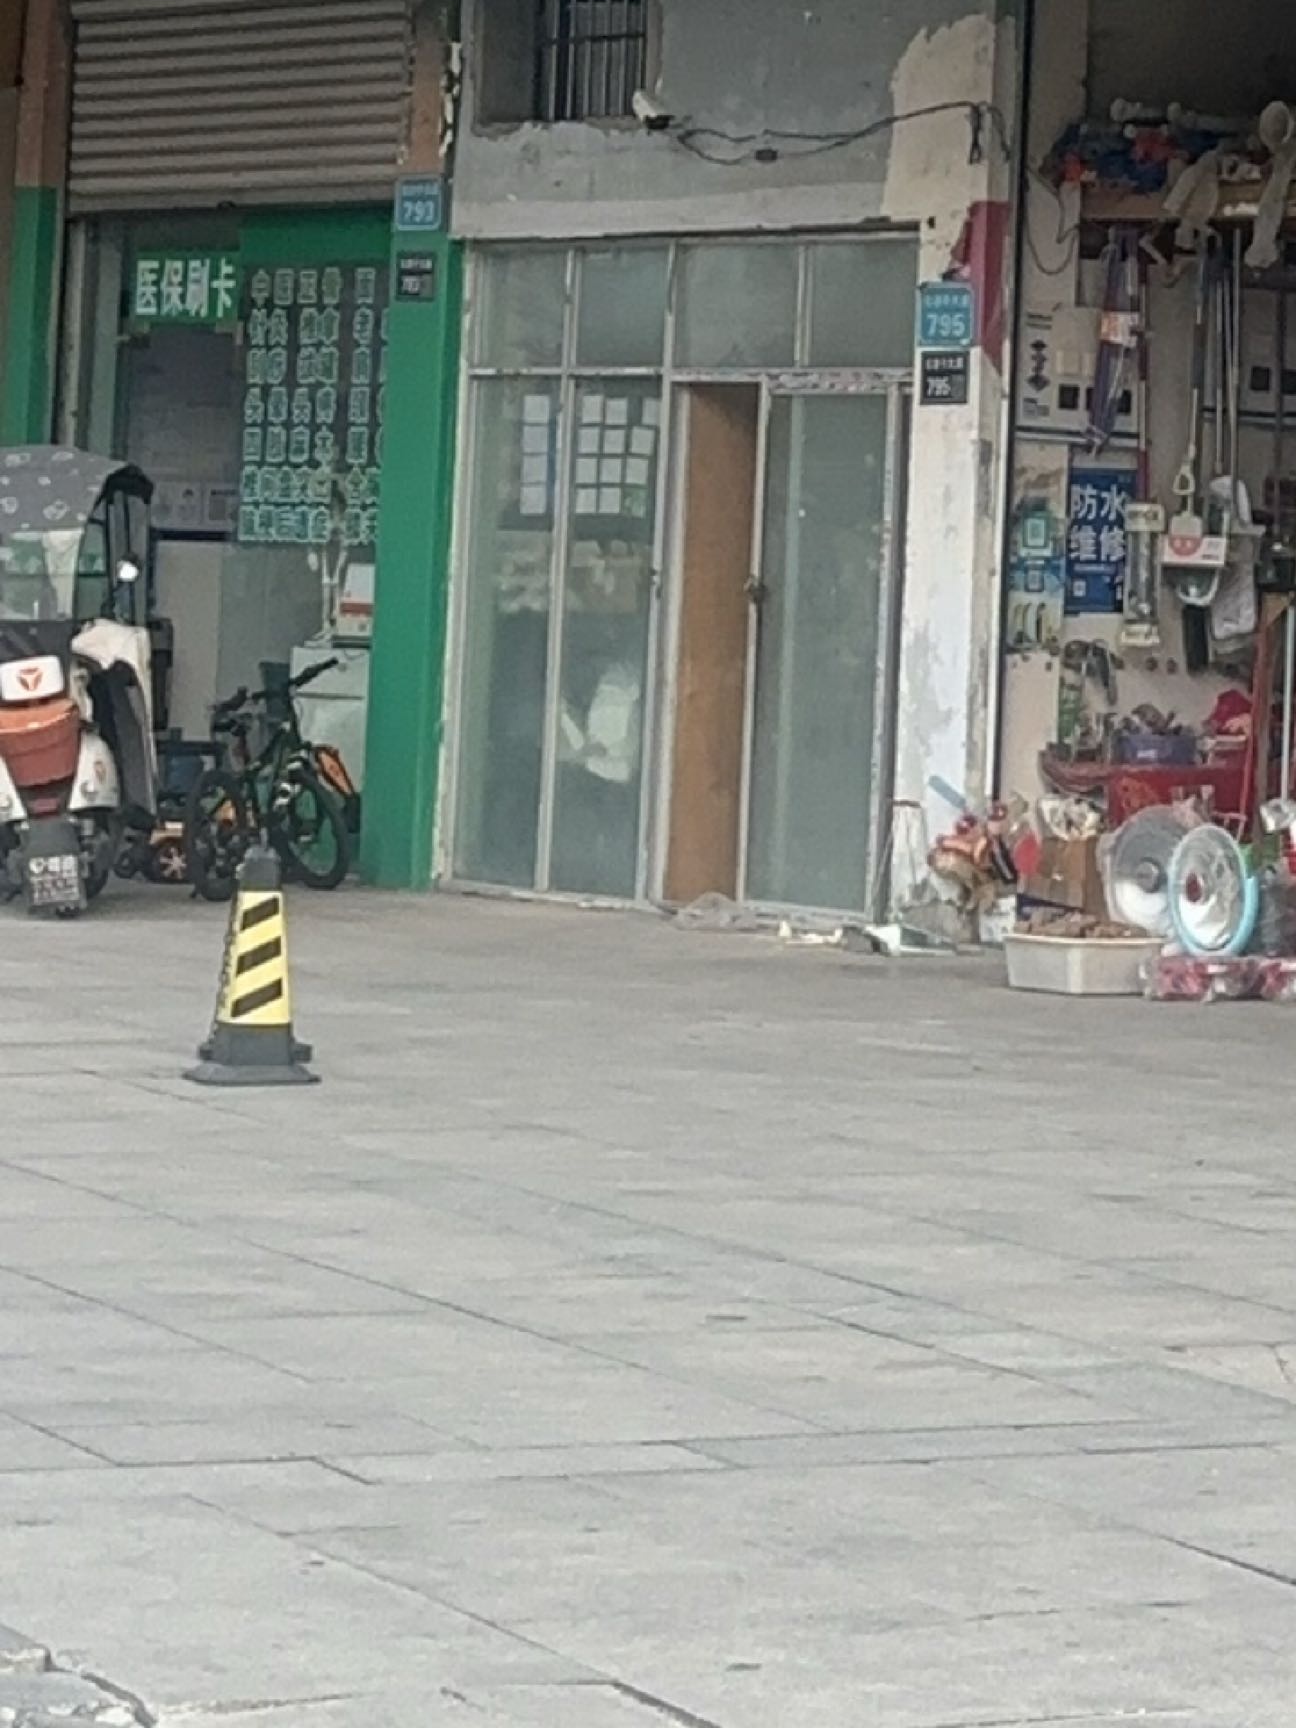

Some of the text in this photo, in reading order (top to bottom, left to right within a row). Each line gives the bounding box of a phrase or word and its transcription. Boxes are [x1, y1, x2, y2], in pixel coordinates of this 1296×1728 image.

[134, 258, 237, 318] 医保刷卡
[926, 312, 967, 338] 795
[1070, 483, 1128, 522] 防水
[1070, 524, 1126, 562] 维修
